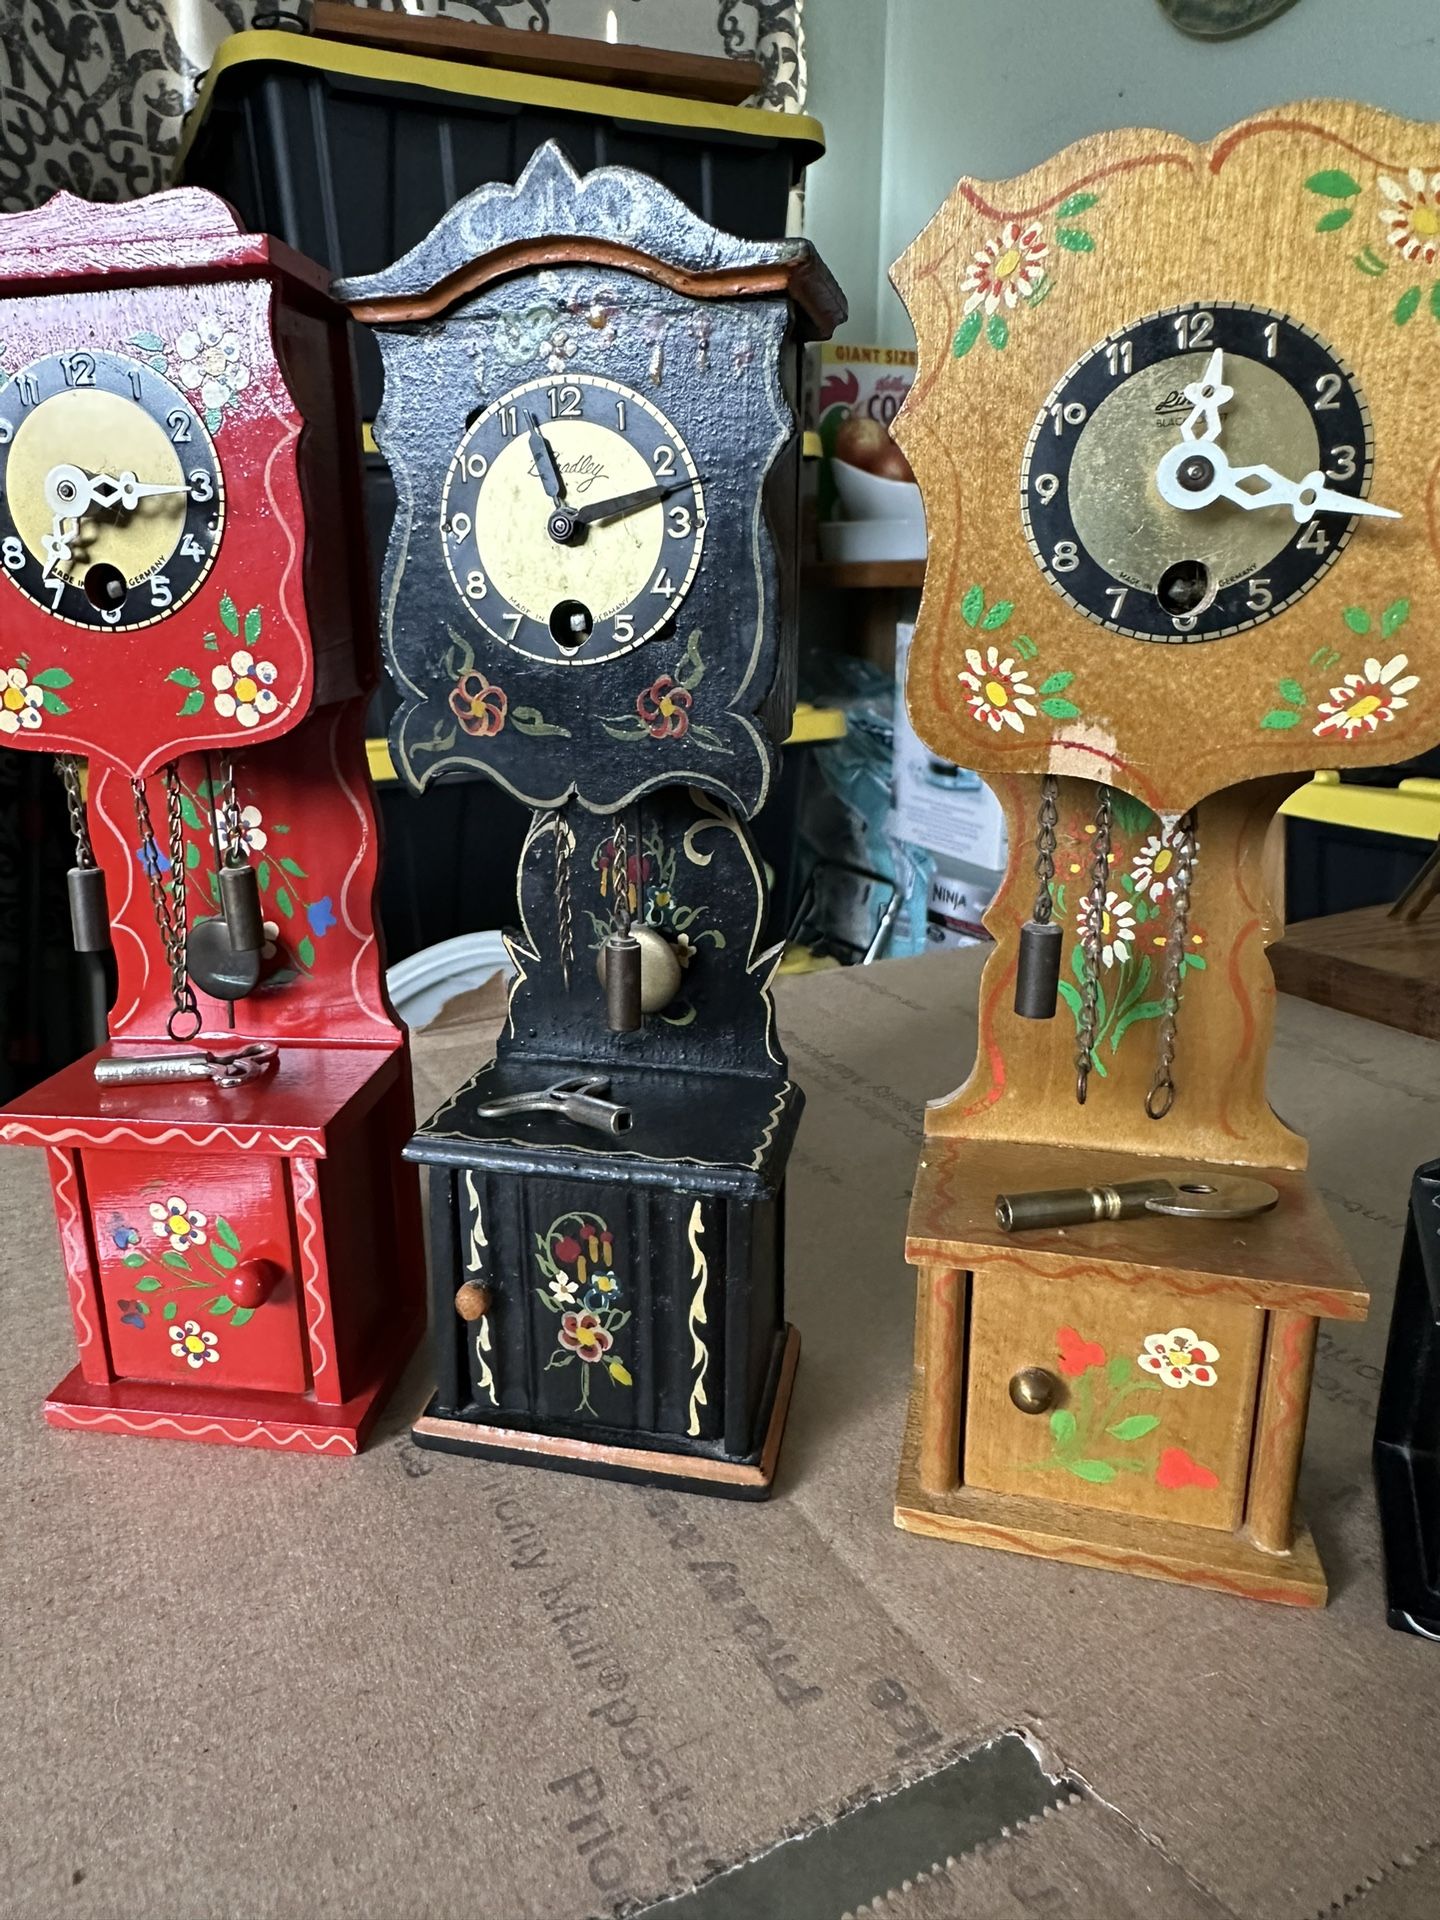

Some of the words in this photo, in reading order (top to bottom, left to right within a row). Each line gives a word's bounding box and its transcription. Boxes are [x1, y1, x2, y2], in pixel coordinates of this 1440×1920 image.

[1173, 311, 1215, 350] 12
[1263, 322, 1279, 358] 1
[60, 352, 96, 386] 12
[835, 346, 879, 362] GIANT
[885, 349, 916, 366] SIZE
[1104, 341, 1134, 376] 11
[15, 373, 40, 406] 11
[127, 371, 142, 400] 1
[547, 386, 582, 417] 12
[1314, 373, 1343, 411] 2
[167, 410, 191, 442] 2
[498, 405, 518, 436] 11
[615, 401, 627, 431] 1
[1050, 402, 1087, 436] 10
[457, 453, 488, 483] 10
[653, 445, 676, 477] 2
[1325, 445, 1356, 481] 3
[190, 470, 213, 501] 3
[1034, 473, 1060, 506] 9
[451, 512, 472, 544] 9
[667, 506, 691, 539] 3
[1296, 520, 1330, 555] 4
[2, 536, 26, 569] 8
[181, 534, 205, 562] 4
[1051, 541, 1079, 573] 8
[128, 555, 166, 587] GERMANY
[466, 571, 487, 600] 8
[650, 568, 676, 598] 4
[1218, 563, 1257, 588] GERMANY
[44, 578, 65, 610] 7
[150, 575, 172, 607] 5
[1104, 587, 1128, 619] 7
[1246, 578, 1273, 612] 5
[503, 613, 524, 641] 7
[612, 614, 634, 643] 5
[932, 883, 966, 910] NINJA
